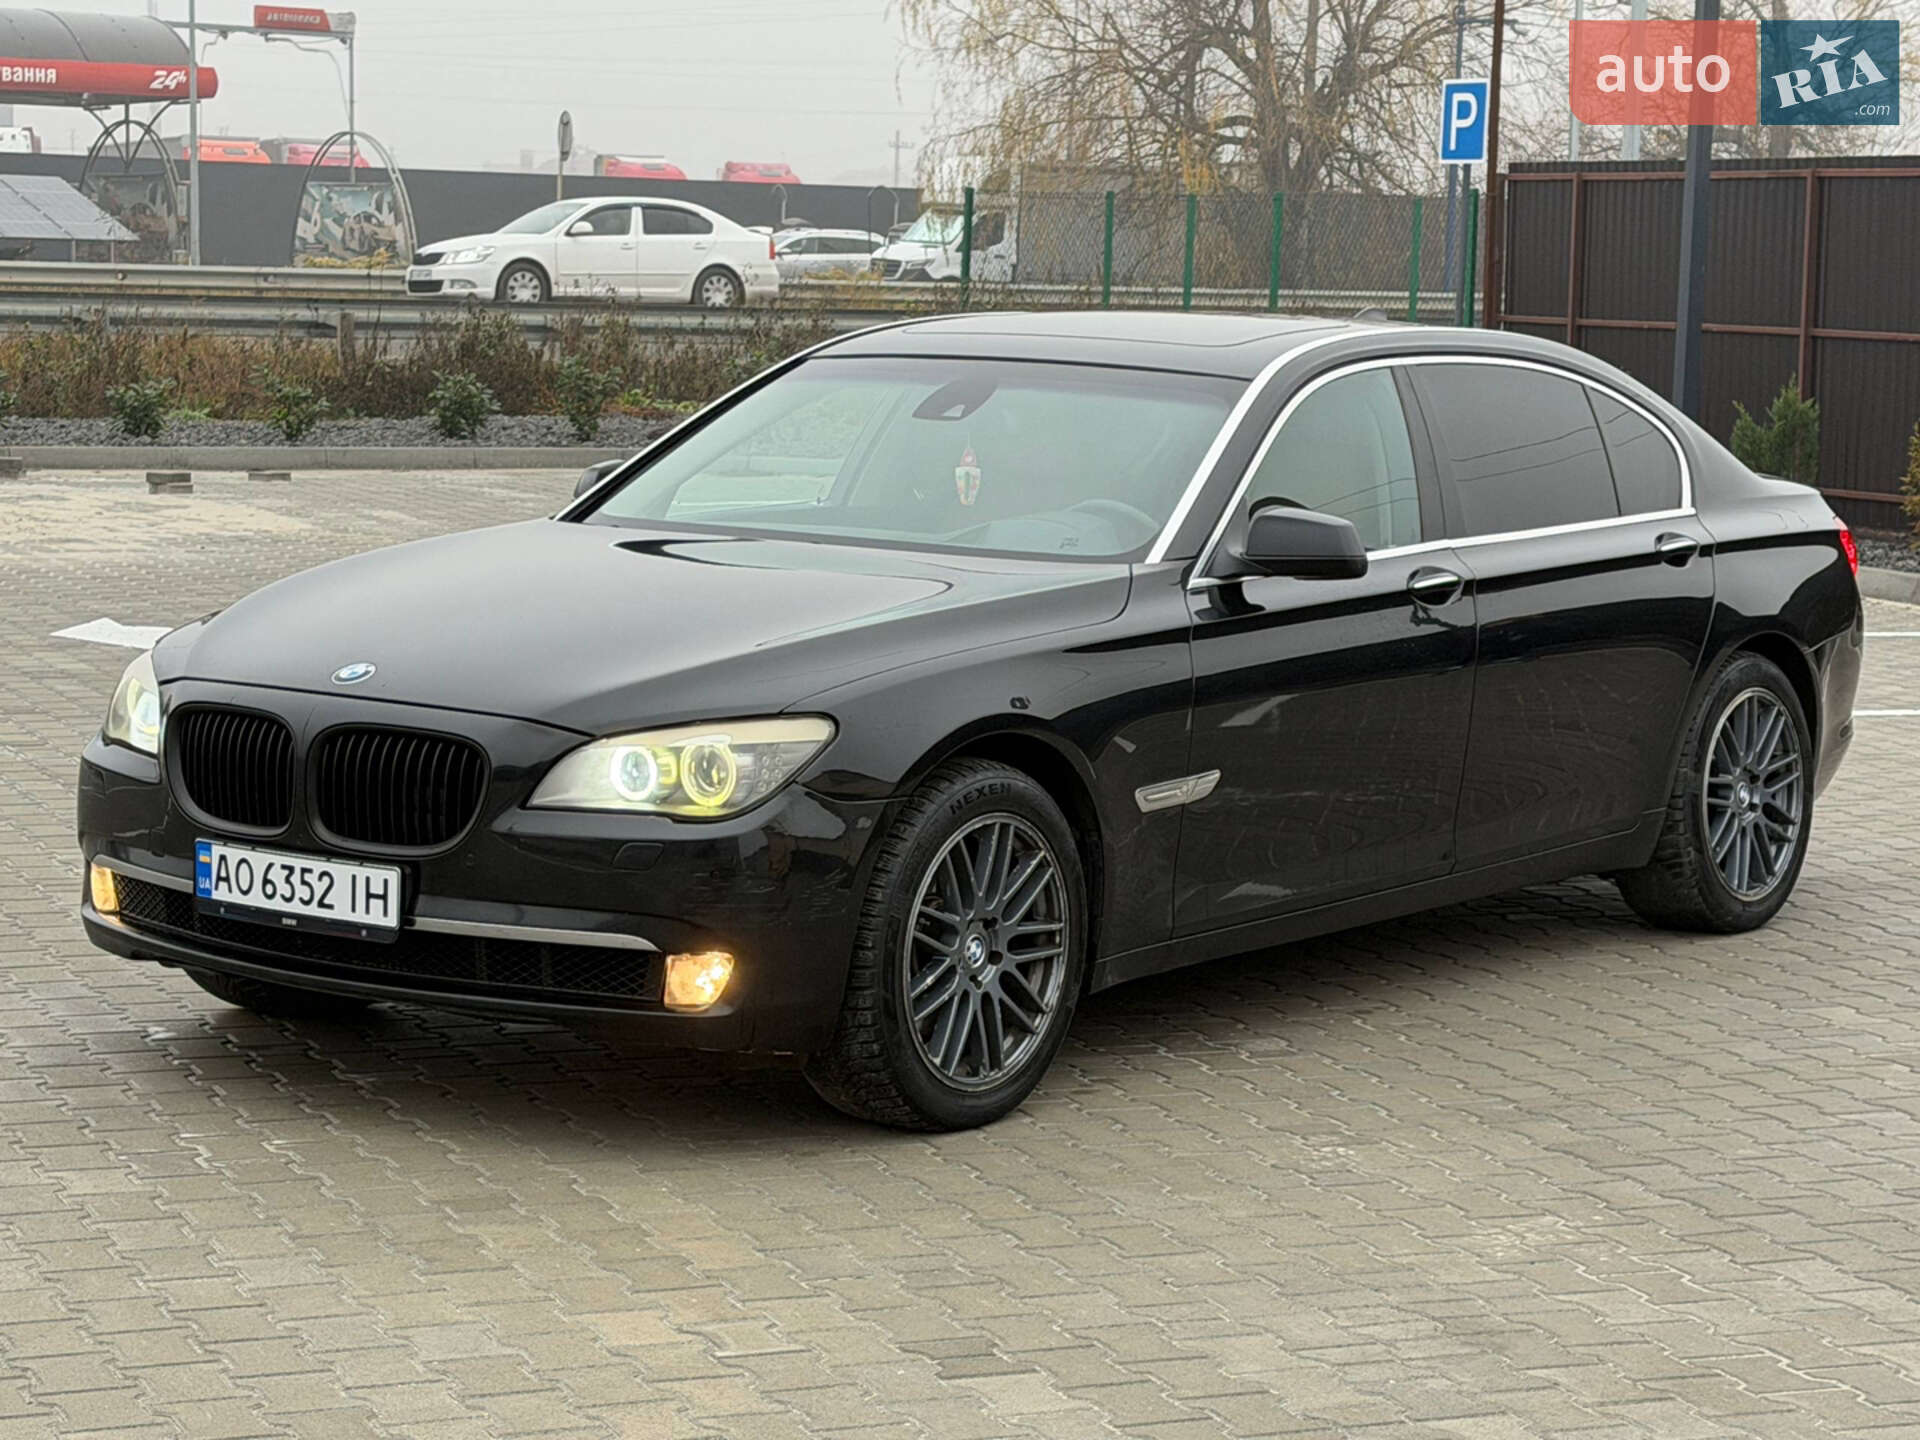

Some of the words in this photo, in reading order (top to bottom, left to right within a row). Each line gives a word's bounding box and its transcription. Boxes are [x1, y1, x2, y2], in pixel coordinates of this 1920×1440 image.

[0, 66, 57, 84] вання
[1449, 92, 1478, 151] P
[949, 783, 1012, 815] NEXEN
[199, 876, 211, 889] UA
[214, 854, 254, 896] AO
[261, 862, 335, 910] 6352
[351, 874, 389, 918] IH
